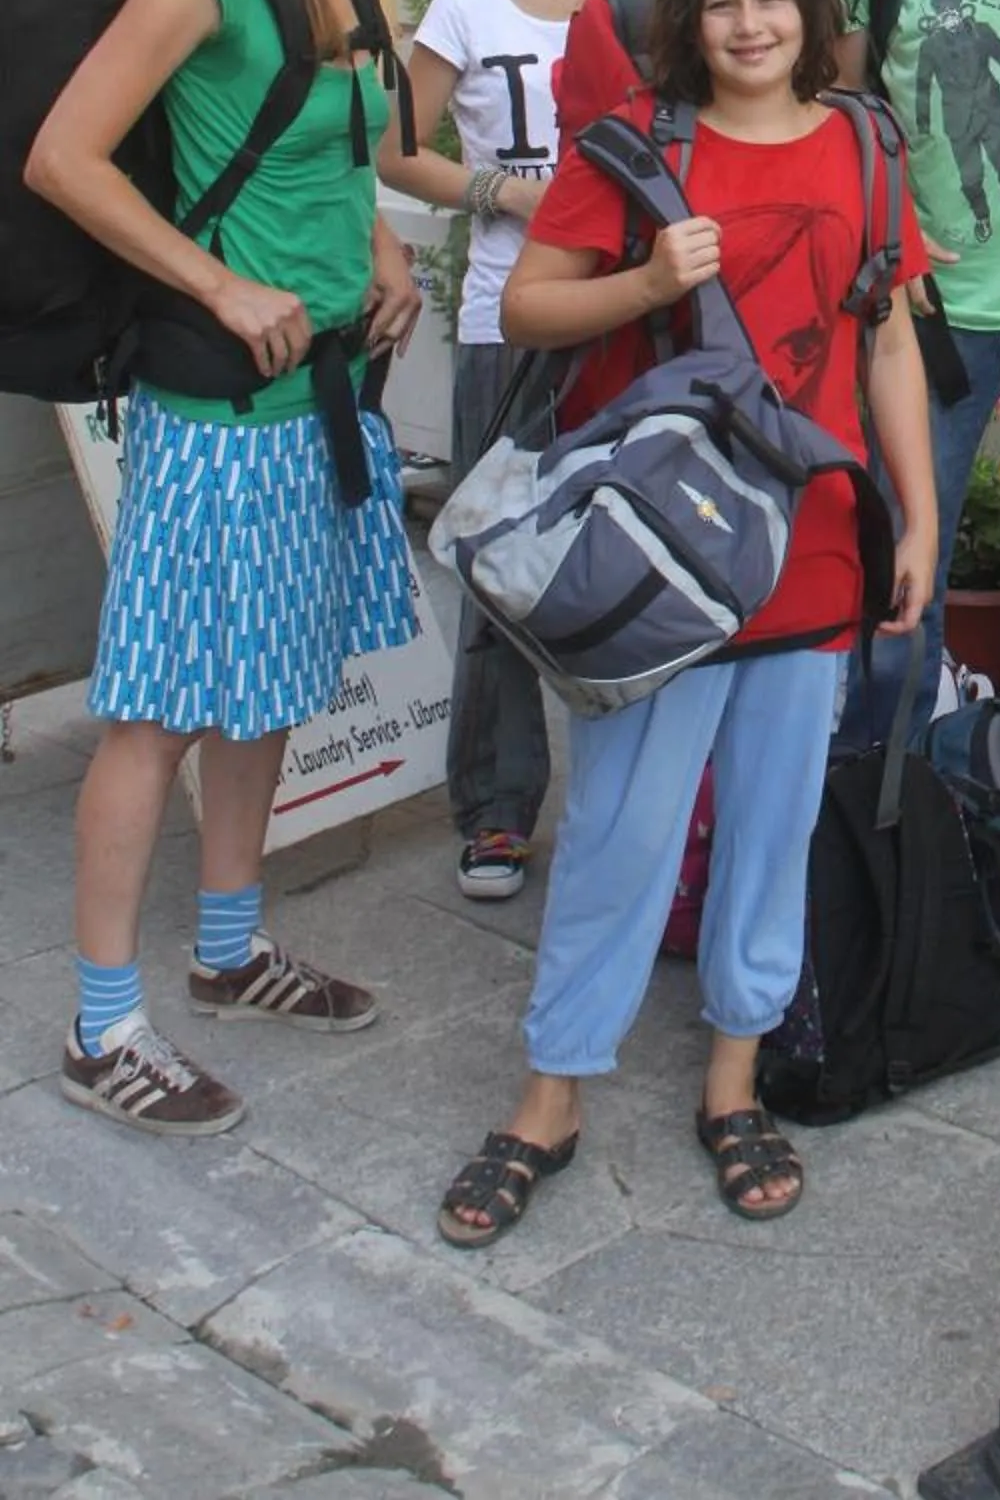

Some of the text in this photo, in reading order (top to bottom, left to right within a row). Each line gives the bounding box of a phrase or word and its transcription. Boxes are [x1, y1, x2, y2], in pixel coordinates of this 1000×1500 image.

[482, 54, 550, 160] I
[293, 733, 355, 775] Laundry
[350, 717, 402, 753] Service
[408, 698, 452, 730] Librar
